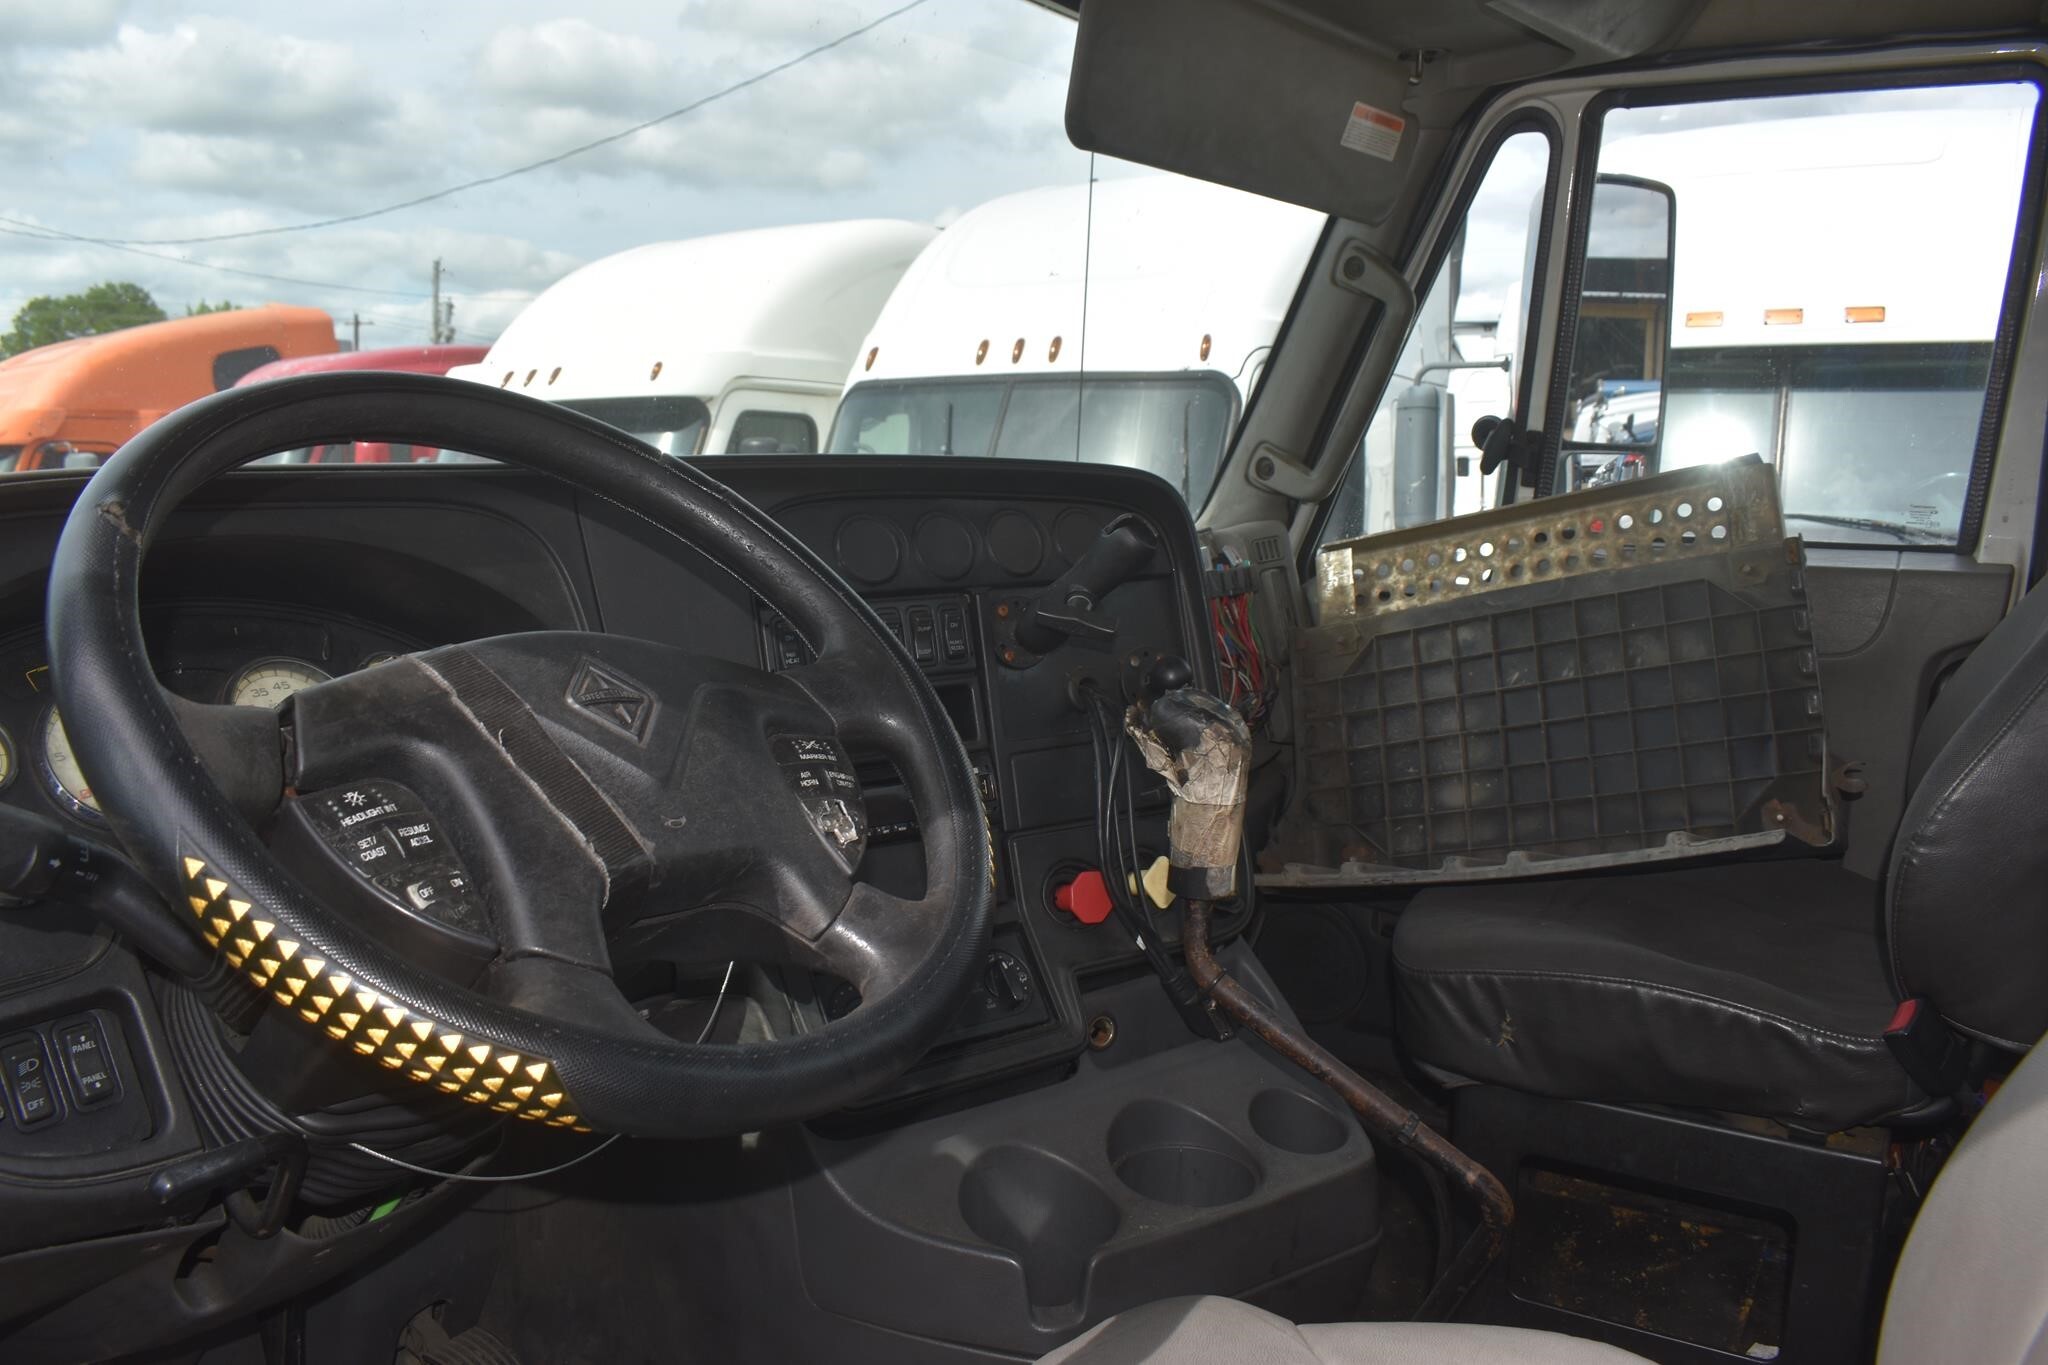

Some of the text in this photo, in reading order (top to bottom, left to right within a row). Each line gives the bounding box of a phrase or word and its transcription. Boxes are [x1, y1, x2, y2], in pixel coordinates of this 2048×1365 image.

[273, 681, 290, 690] 45
[250, 688, 269, 698] 35
[55, 752, 66, 762] 5
[800, 754, 827, 762] MARKER
[800, 778, 819, 787] HORN
[340, 803, 397, 827] HEADLIGHT INT
[357, 835, 377, 849] SET/
[410, 835, 433, 847] ACCEL
[360, 846, 387, 861] COAST
[418, 886, 434, 898] OFF
[72, 1041, 96, 1053] PANEL
[82, 1072, 107, 1085] PANEL
[26, 1097, 45, 1111] OFF
